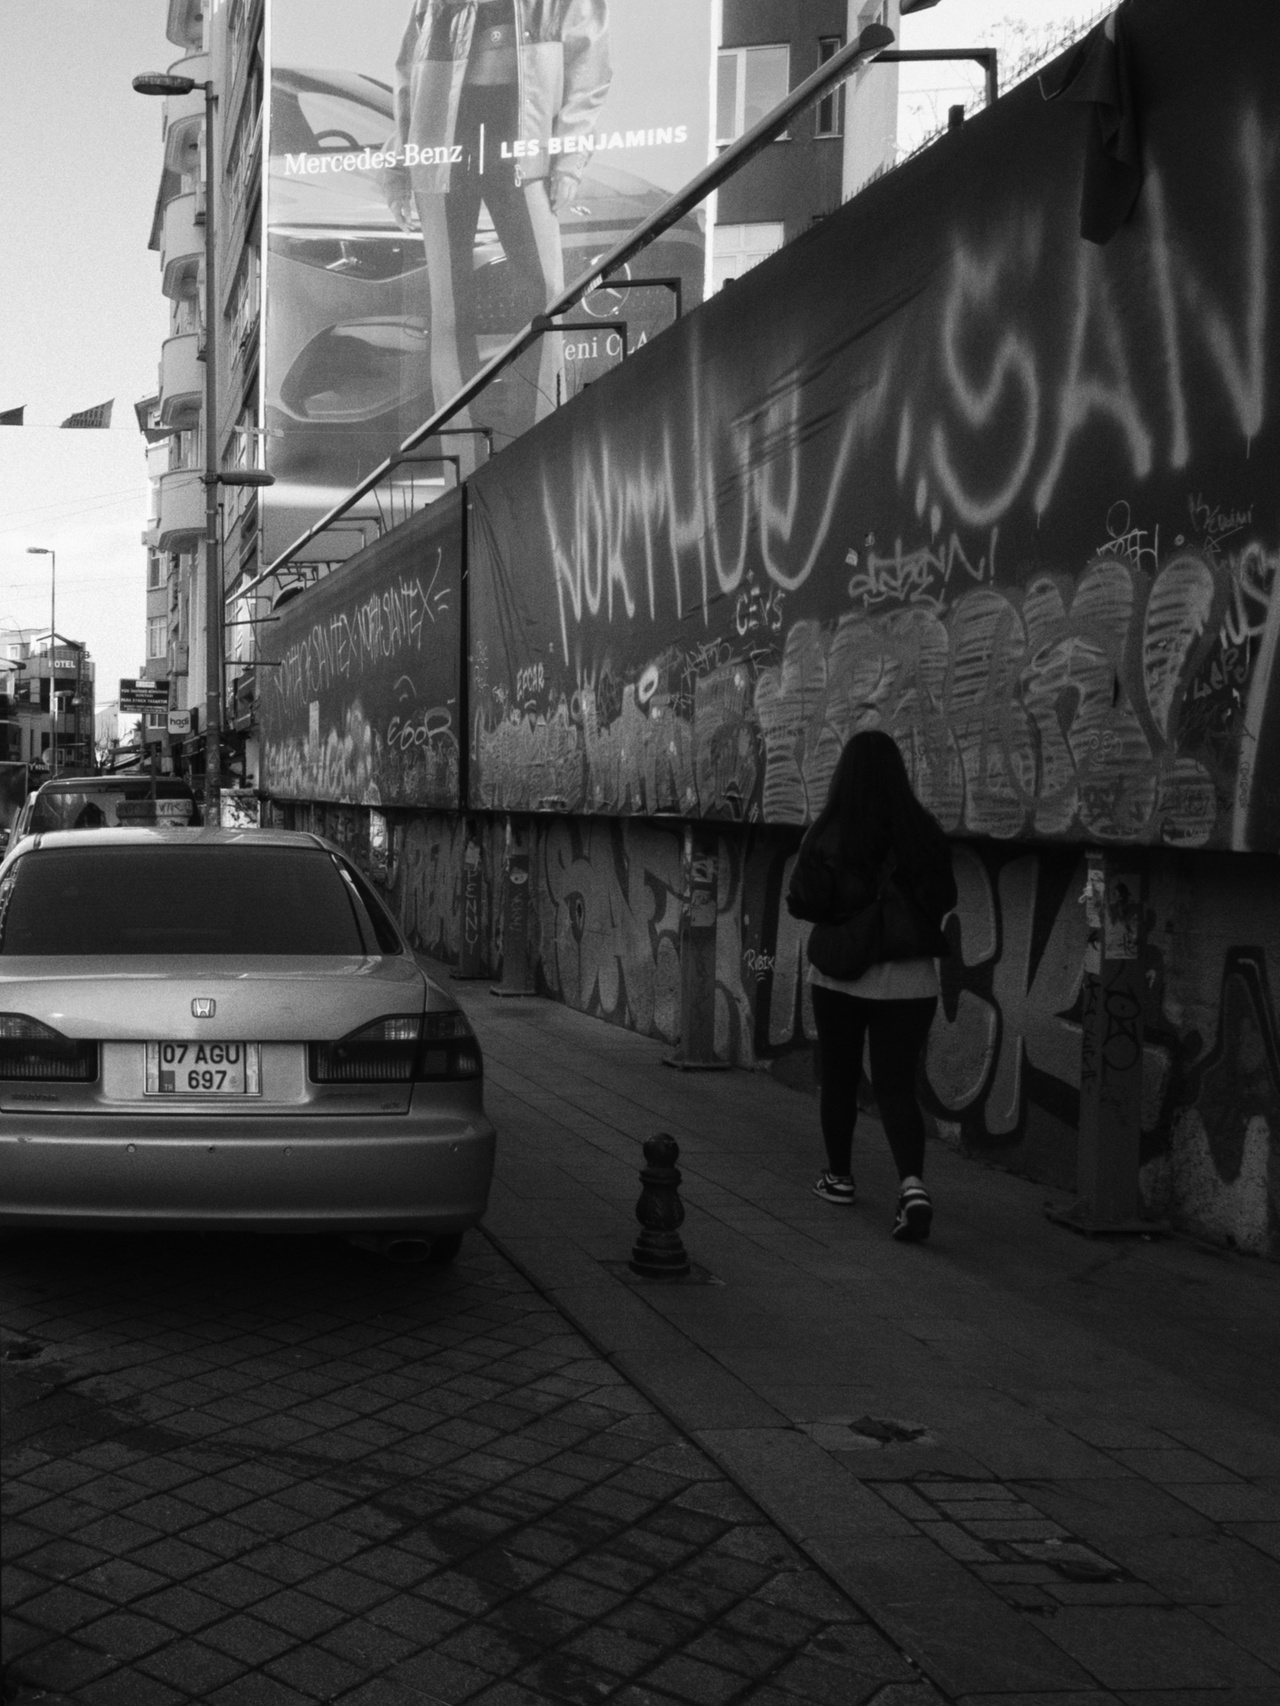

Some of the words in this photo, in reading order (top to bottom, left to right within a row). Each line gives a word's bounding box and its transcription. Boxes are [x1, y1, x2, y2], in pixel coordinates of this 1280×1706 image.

[500, 139, 540, 159] LES
[547, 125, 688, 154] BENJAMINS
[284, 143, 463, 176] Mercedes-Benz
[561, 336, 598, 361] eni
[163, 1043, 189, 1065] 07
[195, 1043, 240, 1065] AGU
[187, 1069, 228, 1091] 697
